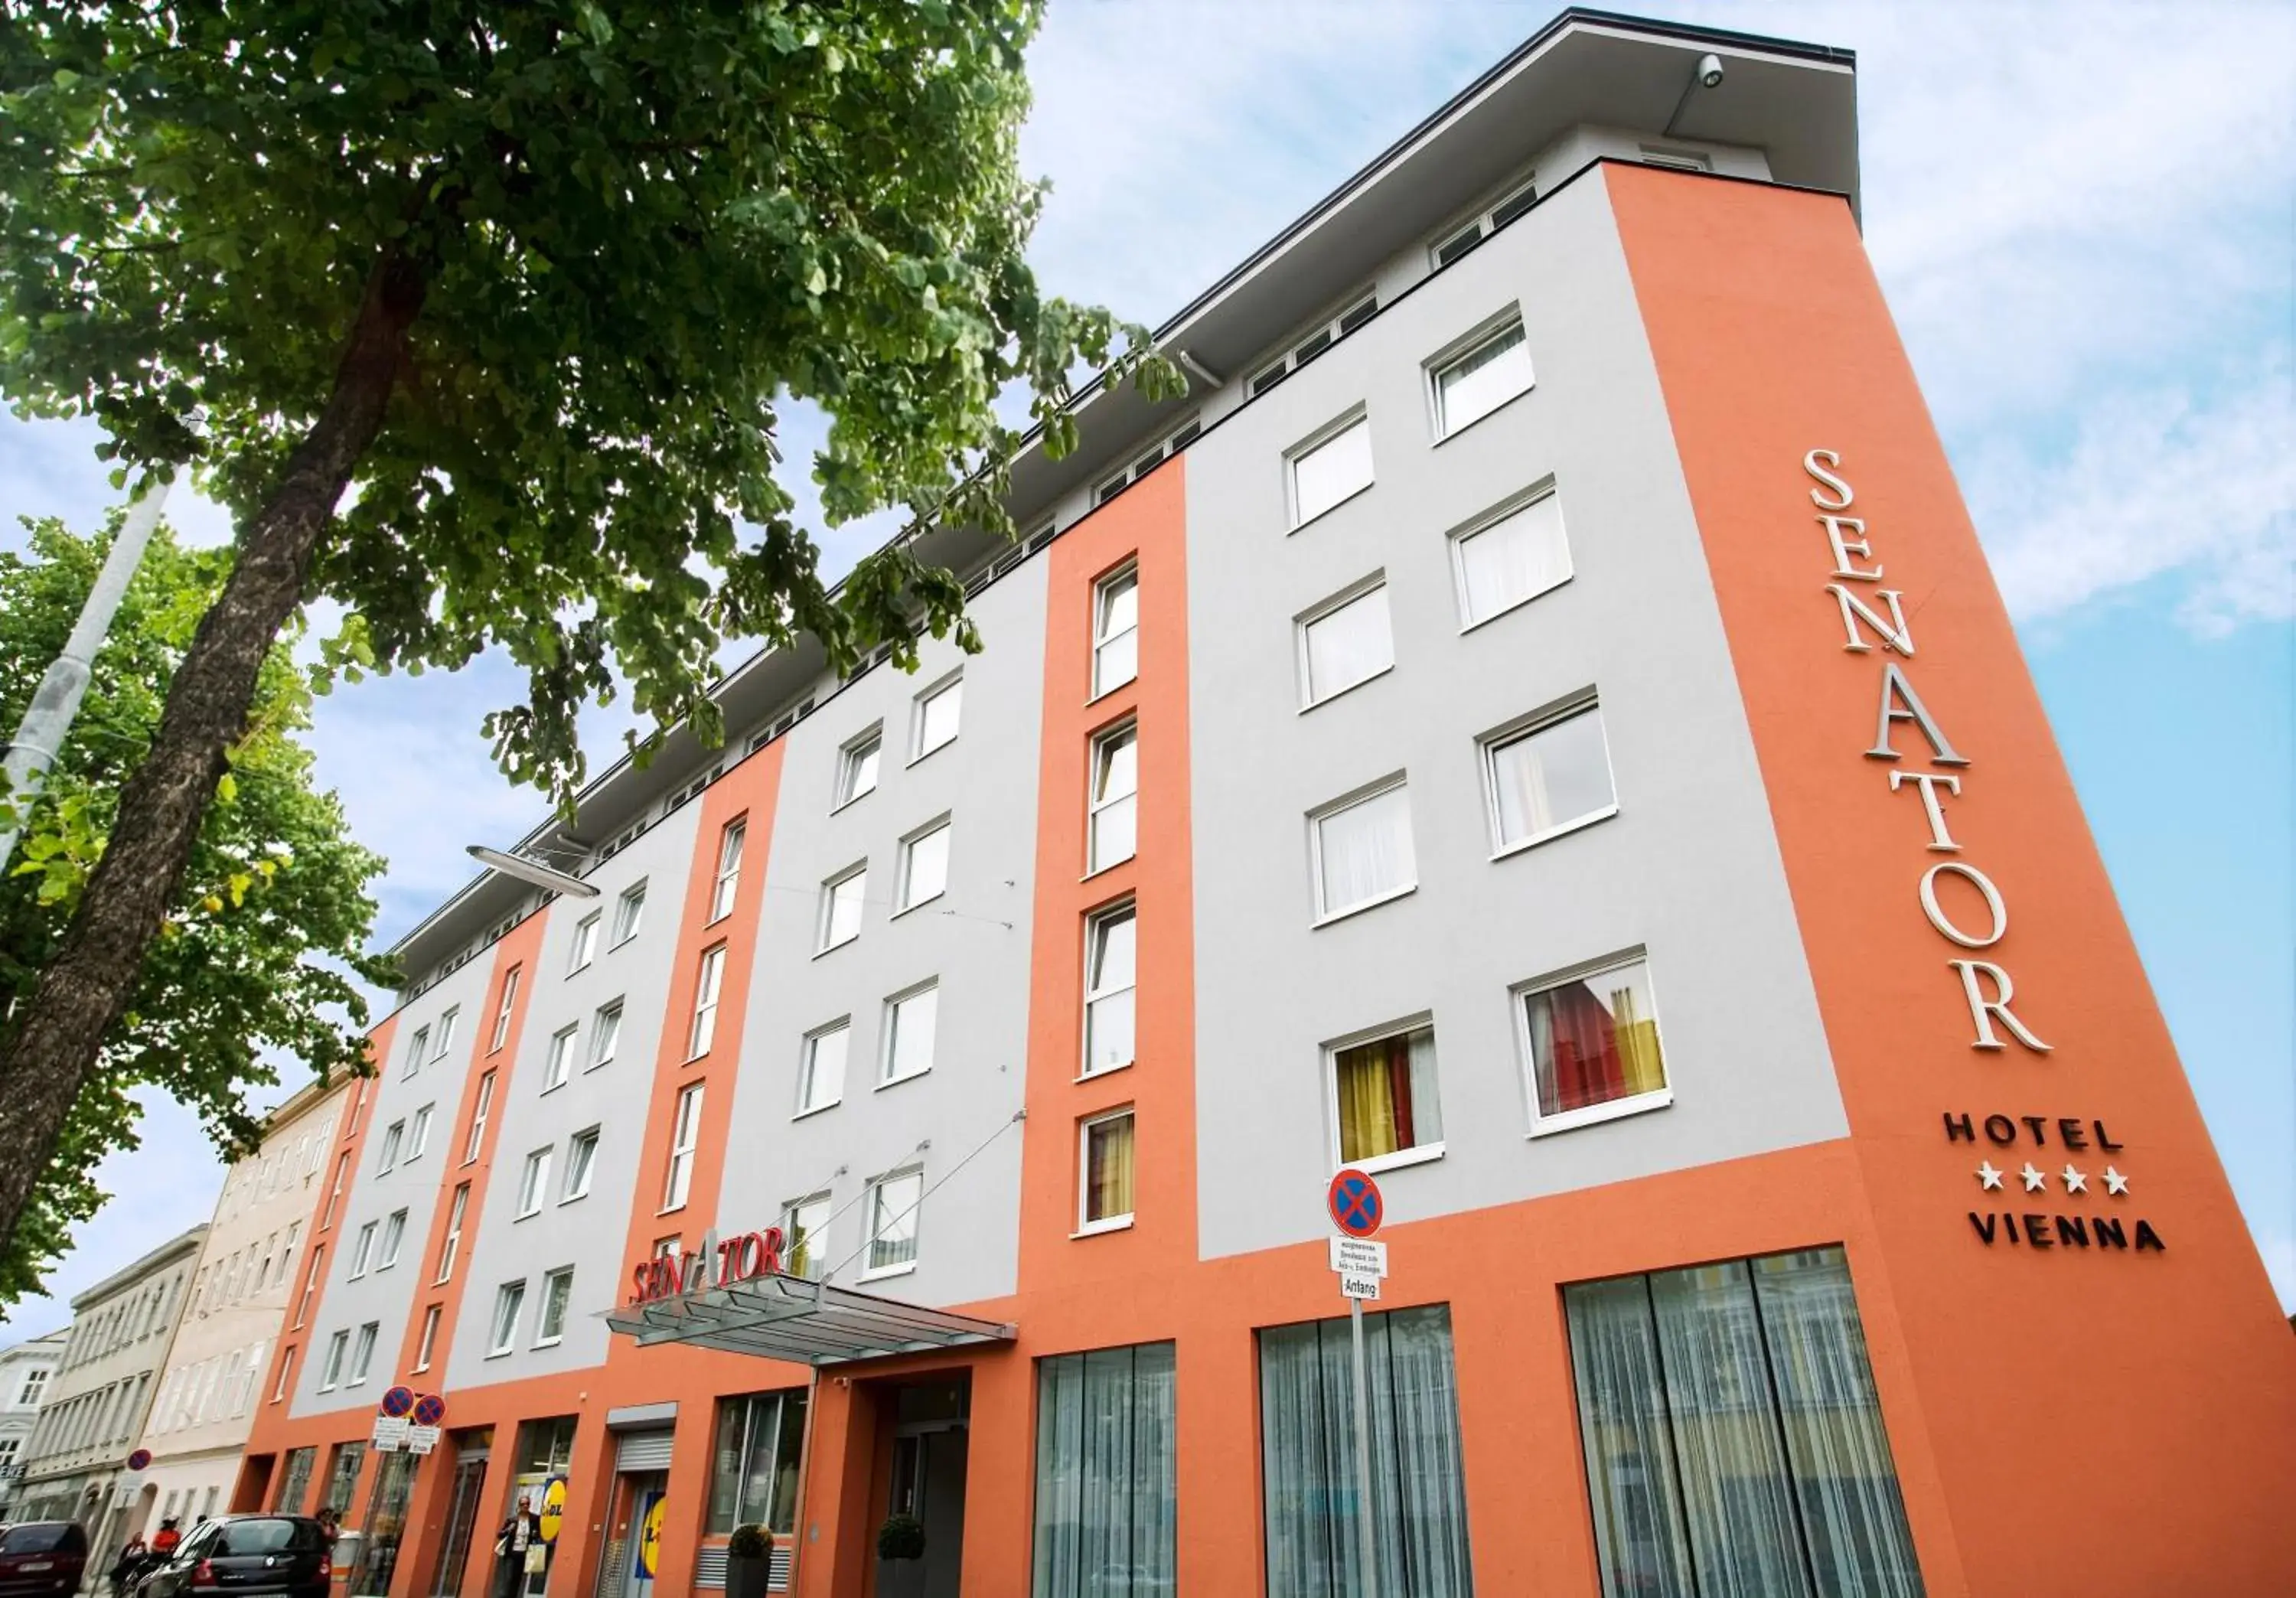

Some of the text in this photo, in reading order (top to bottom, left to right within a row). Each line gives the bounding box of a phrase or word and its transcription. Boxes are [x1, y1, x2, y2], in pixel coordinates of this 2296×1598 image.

[1803, 448, 2056, 1055] SENATOR
[1943, 1111, 2125, 1151] HOTEL
[1968, 1211, 2167, 1250] VIENNA
[629, 1226, 784, 1304] SENATOR
